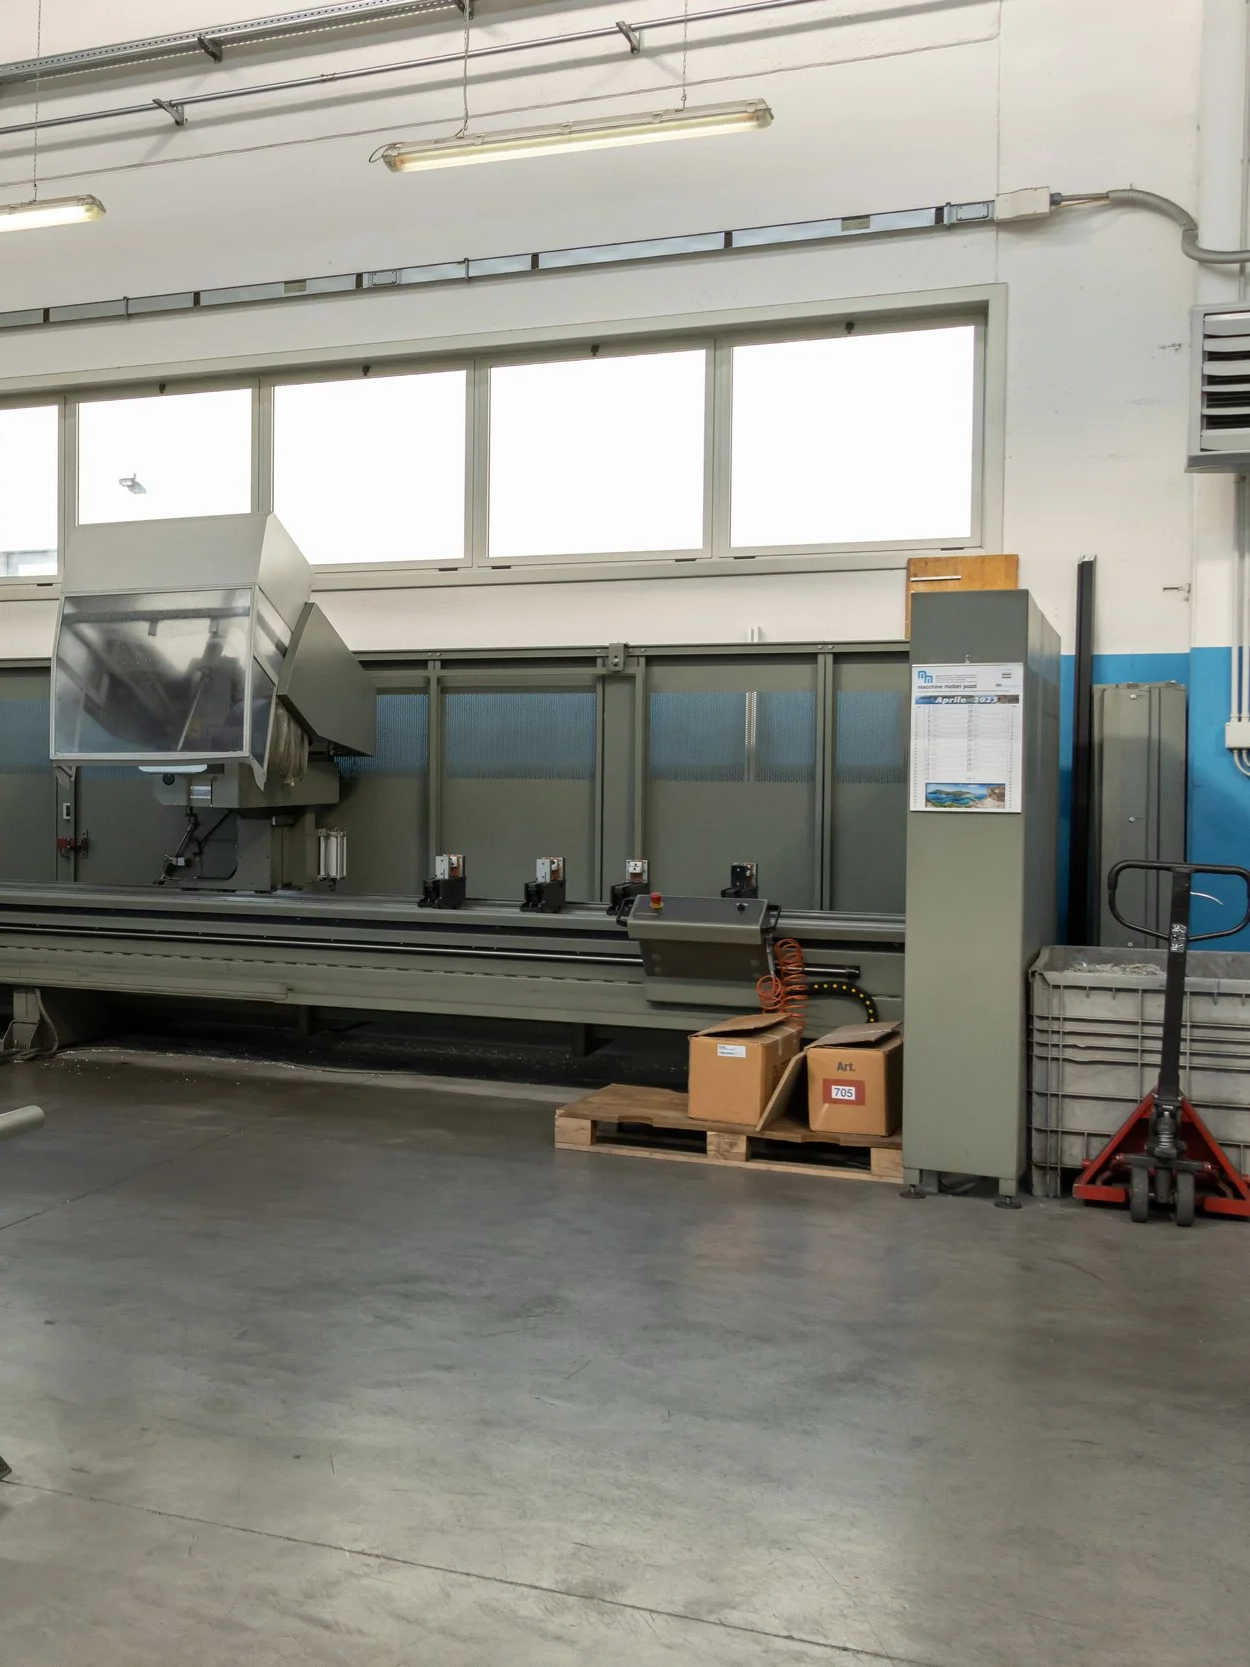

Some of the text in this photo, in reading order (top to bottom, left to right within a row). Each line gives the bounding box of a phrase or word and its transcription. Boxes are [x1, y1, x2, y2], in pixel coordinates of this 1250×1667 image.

[934, 695, 967, 705] Aprile
[836, 1061, 856, 1073] Art.
[833, 1086, 854, 1098] 705
